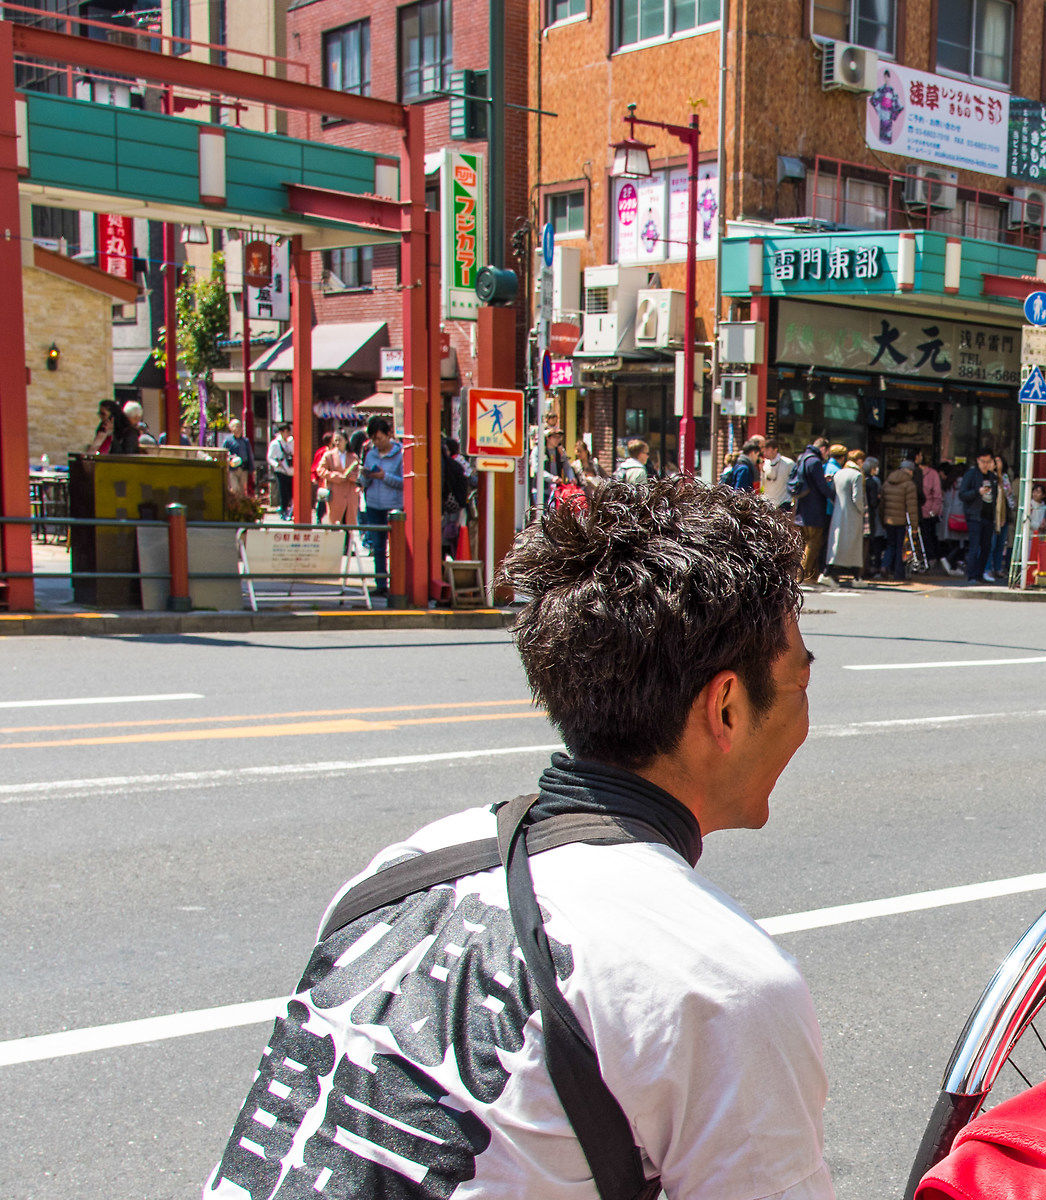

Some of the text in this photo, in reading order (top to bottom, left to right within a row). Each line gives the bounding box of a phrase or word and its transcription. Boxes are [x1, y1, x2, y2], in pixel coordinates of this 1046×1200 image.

[909, 80, 939, 111] 浅草
[941, 87, 971, 105] レンタル
[949, 103, 972, 119] きもの
[1029, 130, 1040, 178] きもの
[455, 195, 475, 286] フジカラー
[773, 246, 879, 280] 雷門東部
[869, 319, 951, 373] 大元
[959, 329, 1014, 354] 浅草雷門
[960, 352, 982, 367] TEL
